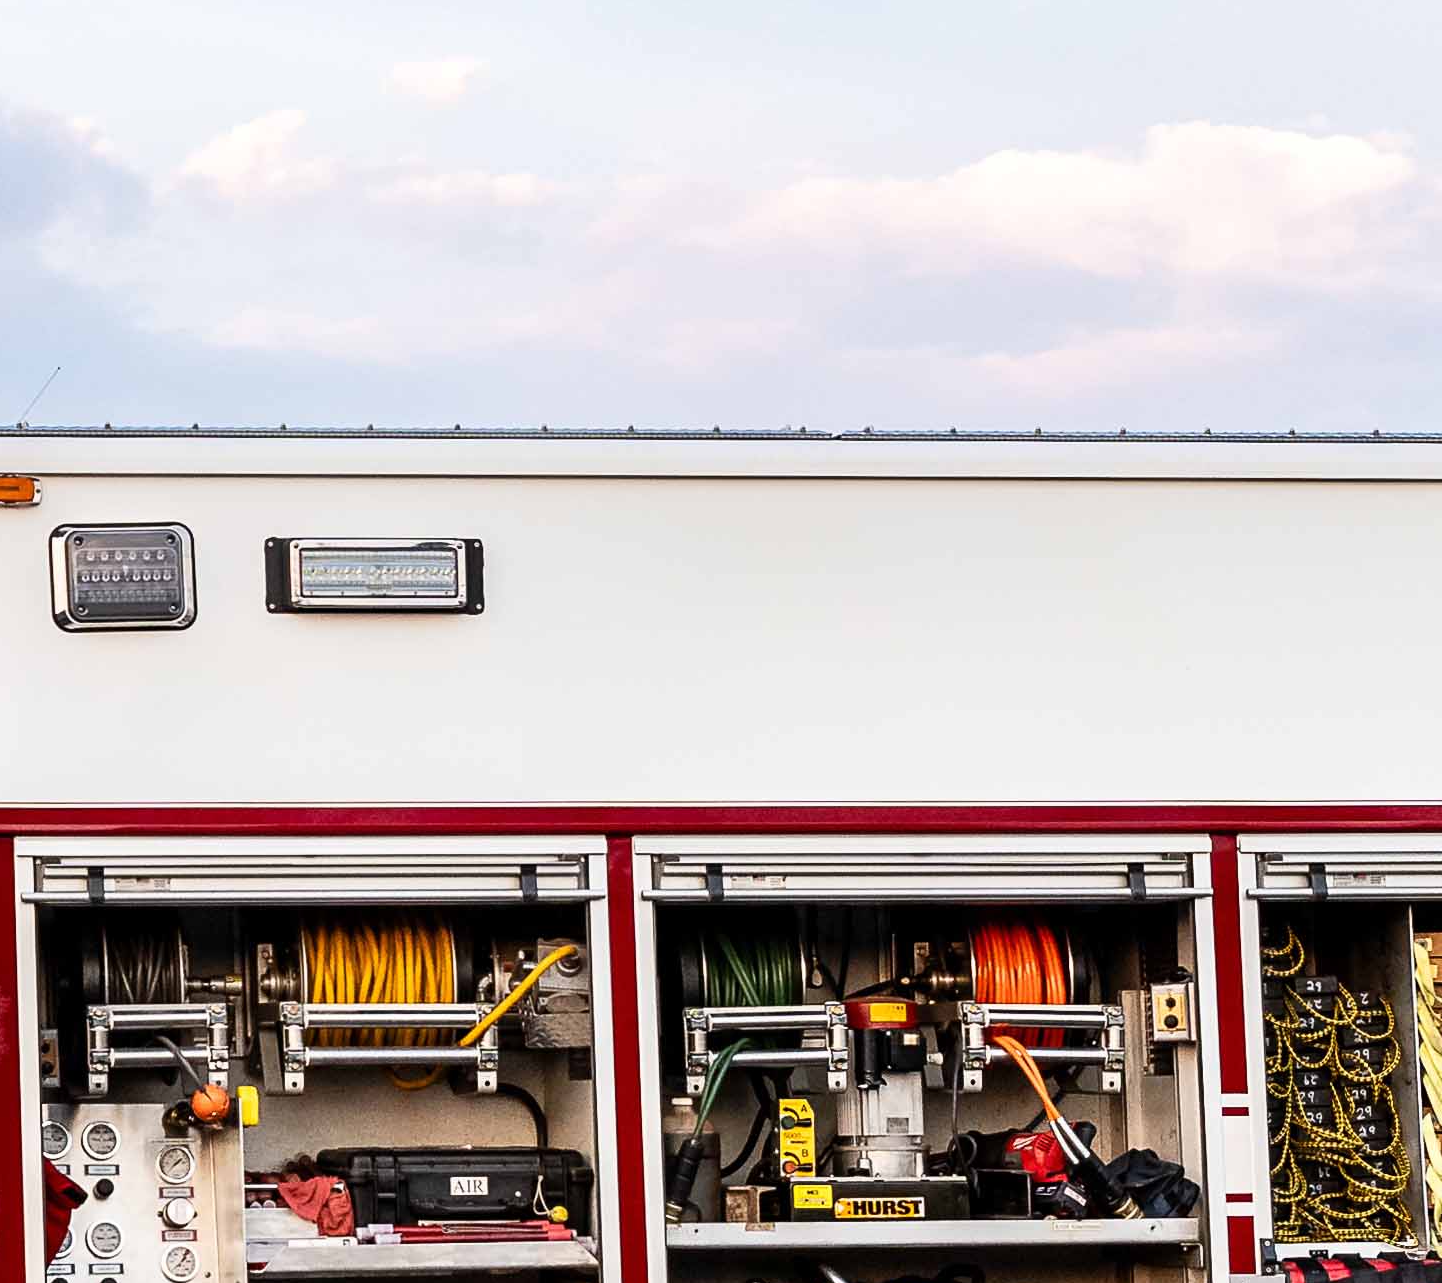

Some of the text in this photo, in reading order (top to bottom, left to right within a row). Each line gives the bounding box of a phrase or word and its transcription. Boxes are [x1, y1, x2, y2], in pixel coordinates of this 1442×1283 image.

[1306, 980, 1323, 992] 29
[800, 1104, 808, 1113] A
[801, 1149, 809, 1158] B
[454, 1179, 484, 1193] AIR
[853, 1200, 922, 1215] HURST
